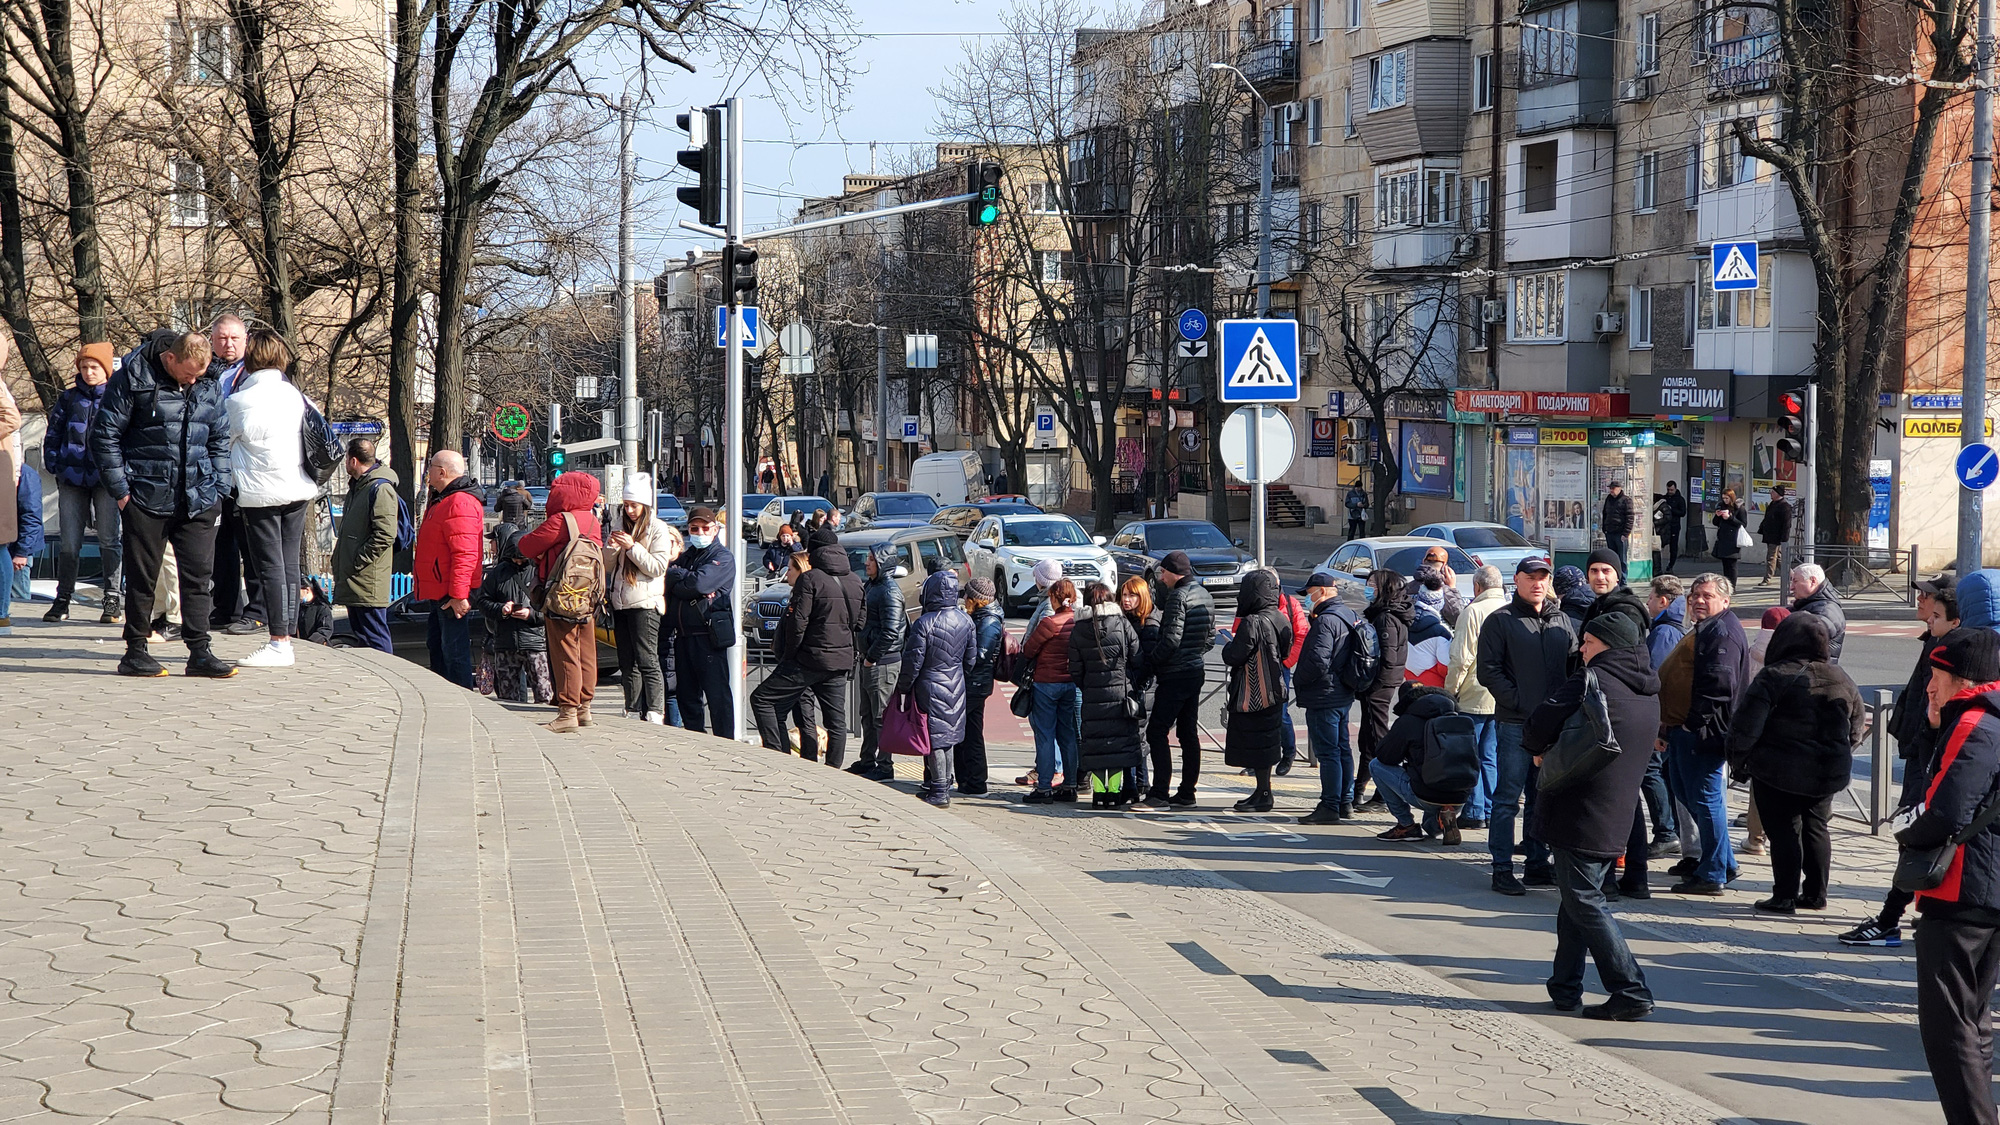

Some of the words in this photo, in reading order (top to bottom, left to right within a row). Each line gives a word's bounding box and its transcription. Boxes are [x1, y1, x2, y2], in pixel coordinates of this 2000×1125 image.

[1662, 377, 1697, 387] ЛОМБАРД
[1470, 394, 1521, 408] КАНЦТОВАРИ
[1537, 396, 1590, 412] ПОДАРУНКИ
[1042, 416, 1051, 429] P
[1910, 422, 1988, 434] ЛОМБ
[907, 424, 915, 435] P
[1553, 431, 1587, 442] 7000
[553, 453, 564, 465] 15
[1425, 455, 1446, 465] БІЛЬШЕ
